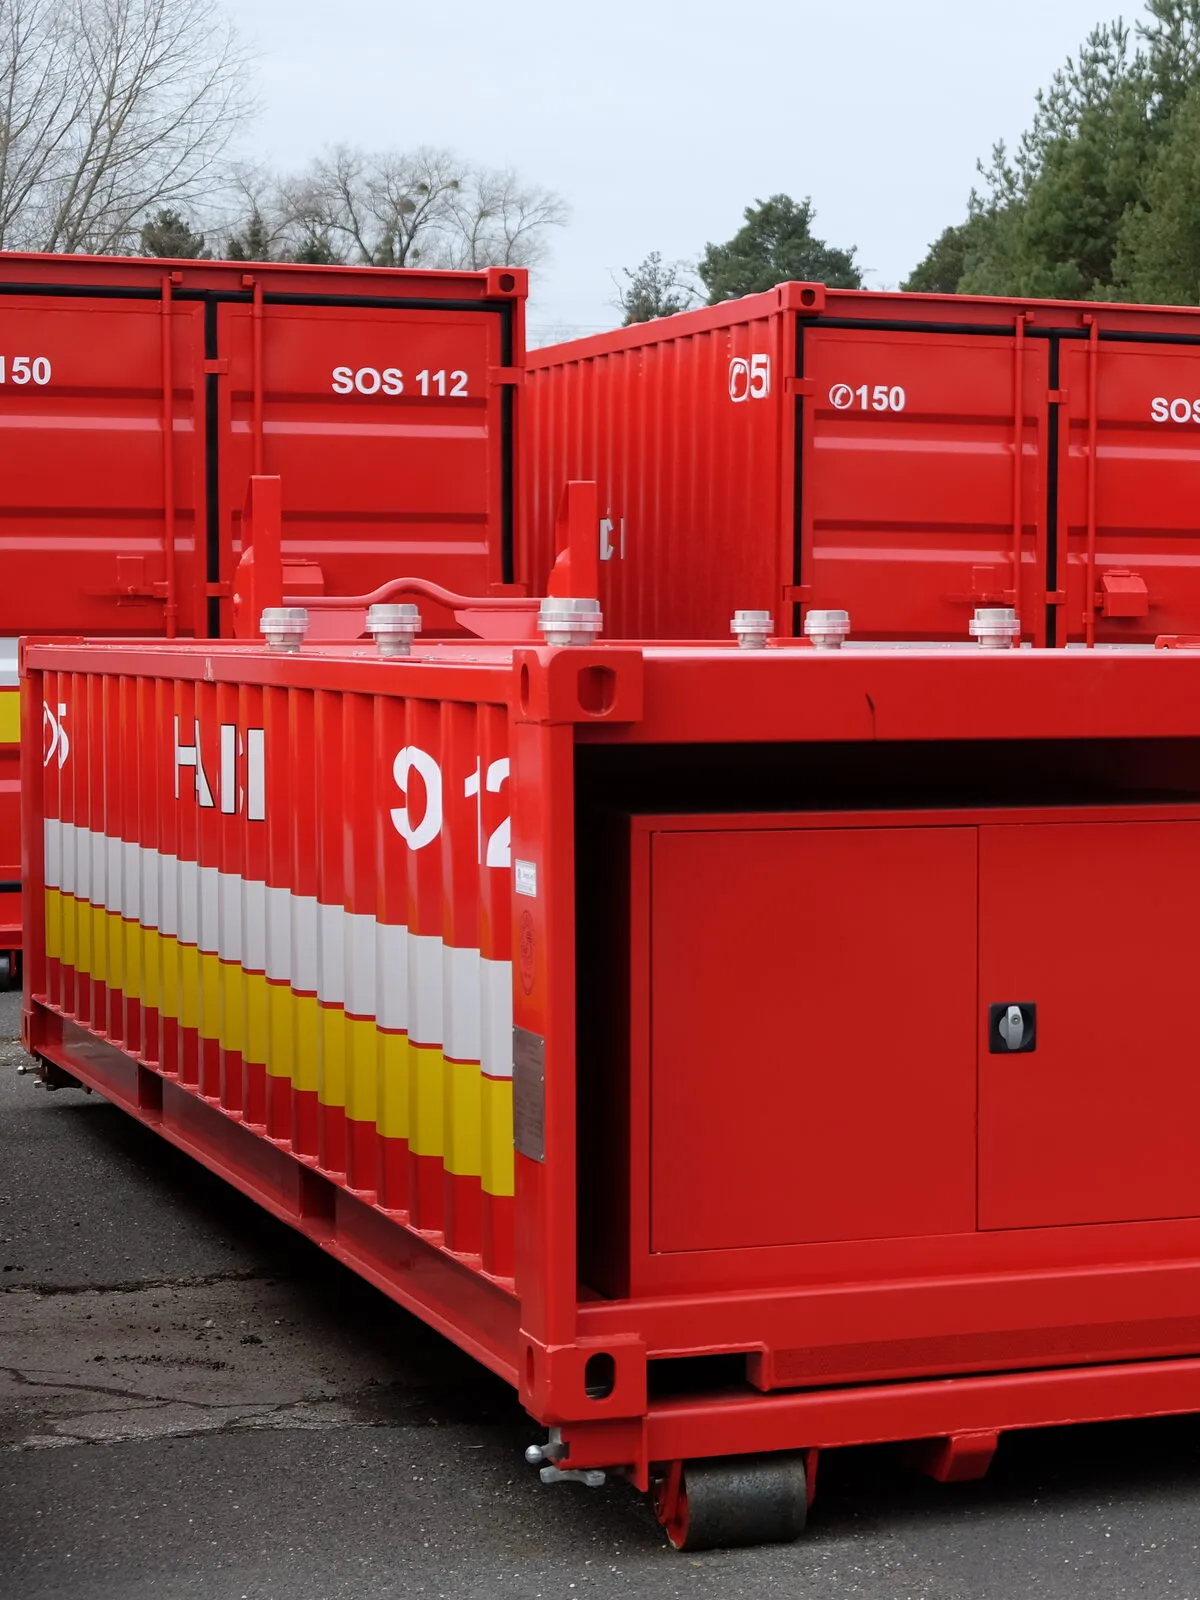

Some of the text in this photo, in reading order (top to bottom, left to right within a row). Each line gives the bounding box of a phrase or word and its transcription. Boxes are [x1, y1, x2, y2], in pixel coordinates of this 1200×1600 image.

[332, 366, 468, 397] SOS 112
[855, 384, 906, 412] 150
